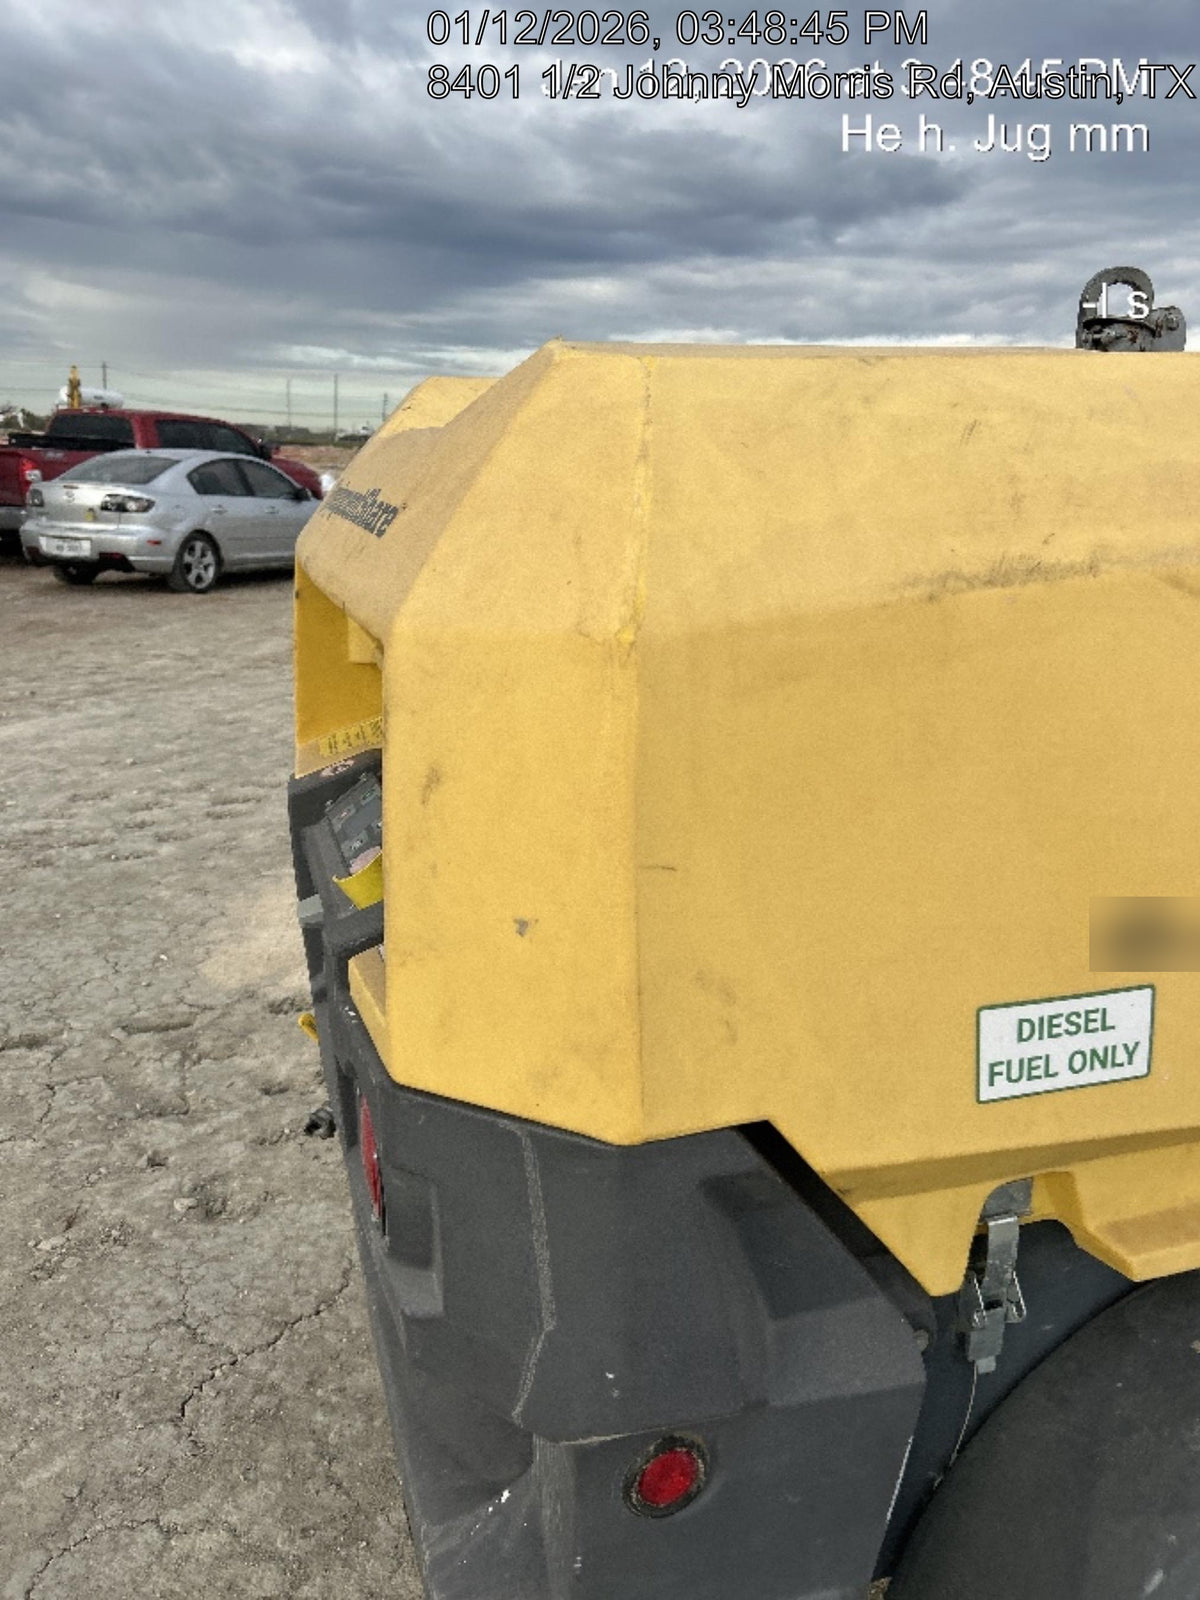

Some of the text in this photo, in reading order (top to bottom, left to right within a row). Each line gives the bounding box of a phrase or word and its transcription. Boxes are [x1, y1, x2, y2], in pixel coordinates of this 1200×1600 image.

[1017, 1007, 1116, 1044] DIESEL
[988, 1041, 1141, 1087] FUEL ONLY
